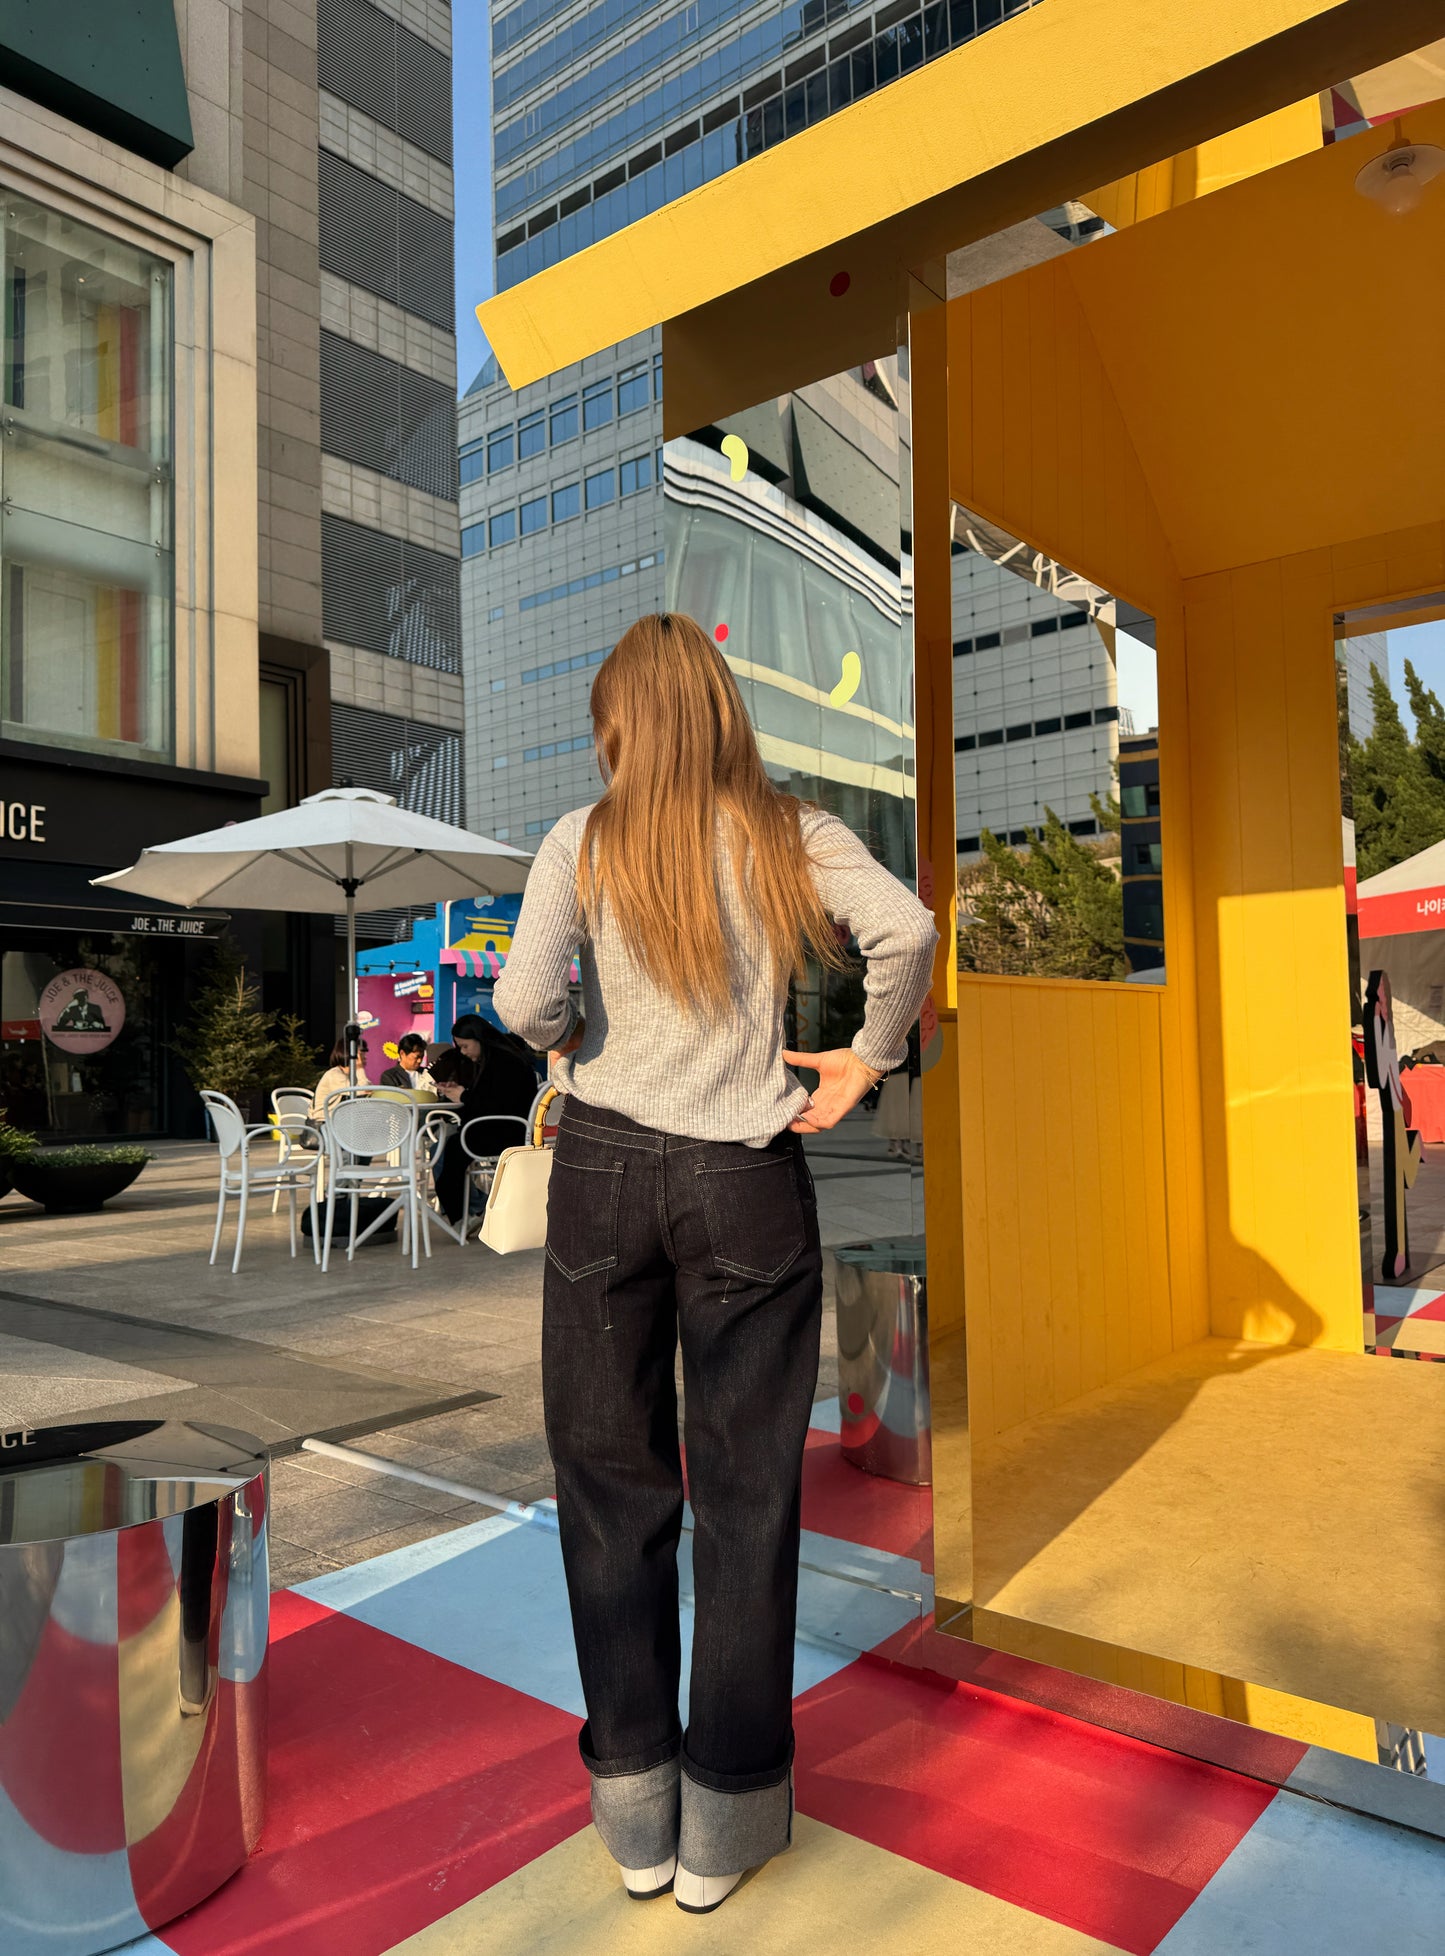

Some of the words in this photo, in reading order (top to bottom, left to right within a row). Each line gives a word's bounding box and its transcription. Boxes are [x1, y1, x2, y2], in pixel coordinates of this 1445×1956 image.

[131, 917, 150, 931] JOE
[157, 918, 176, 933] THE
[177, 920, 205, 934] JUICE
[45, 982, 62, 1003] JOE
[62, 977, 71, 987] &
[72, 973, 93, 985] THE
[94, 979, 119, 1004] JUICE
